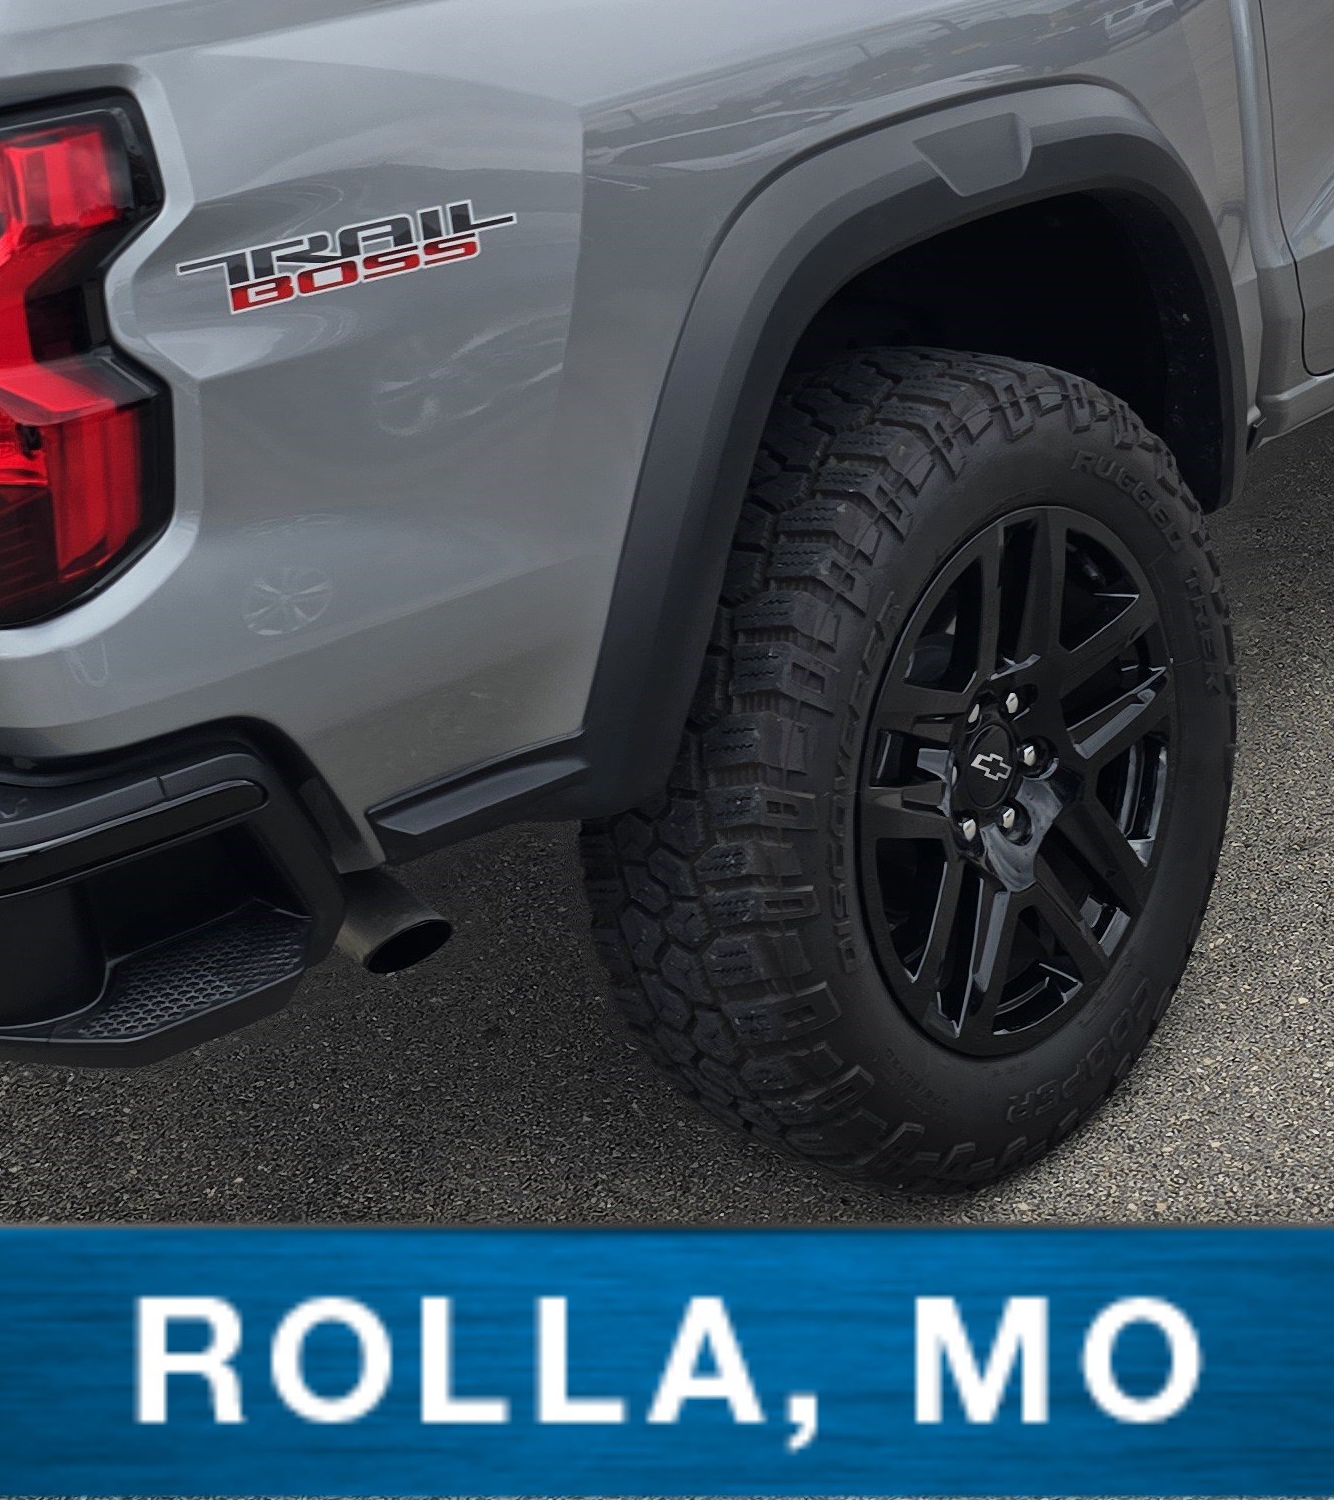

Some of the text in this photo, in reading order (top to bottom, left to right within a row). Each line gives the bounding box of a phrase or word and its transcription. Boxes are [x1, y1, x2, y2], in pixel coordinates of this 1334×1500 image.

[175, 198, 517, 287] TRAIL
[227, 230, 481, 316] BOSS
[1069, 450, 1186, 553] RUGGED
